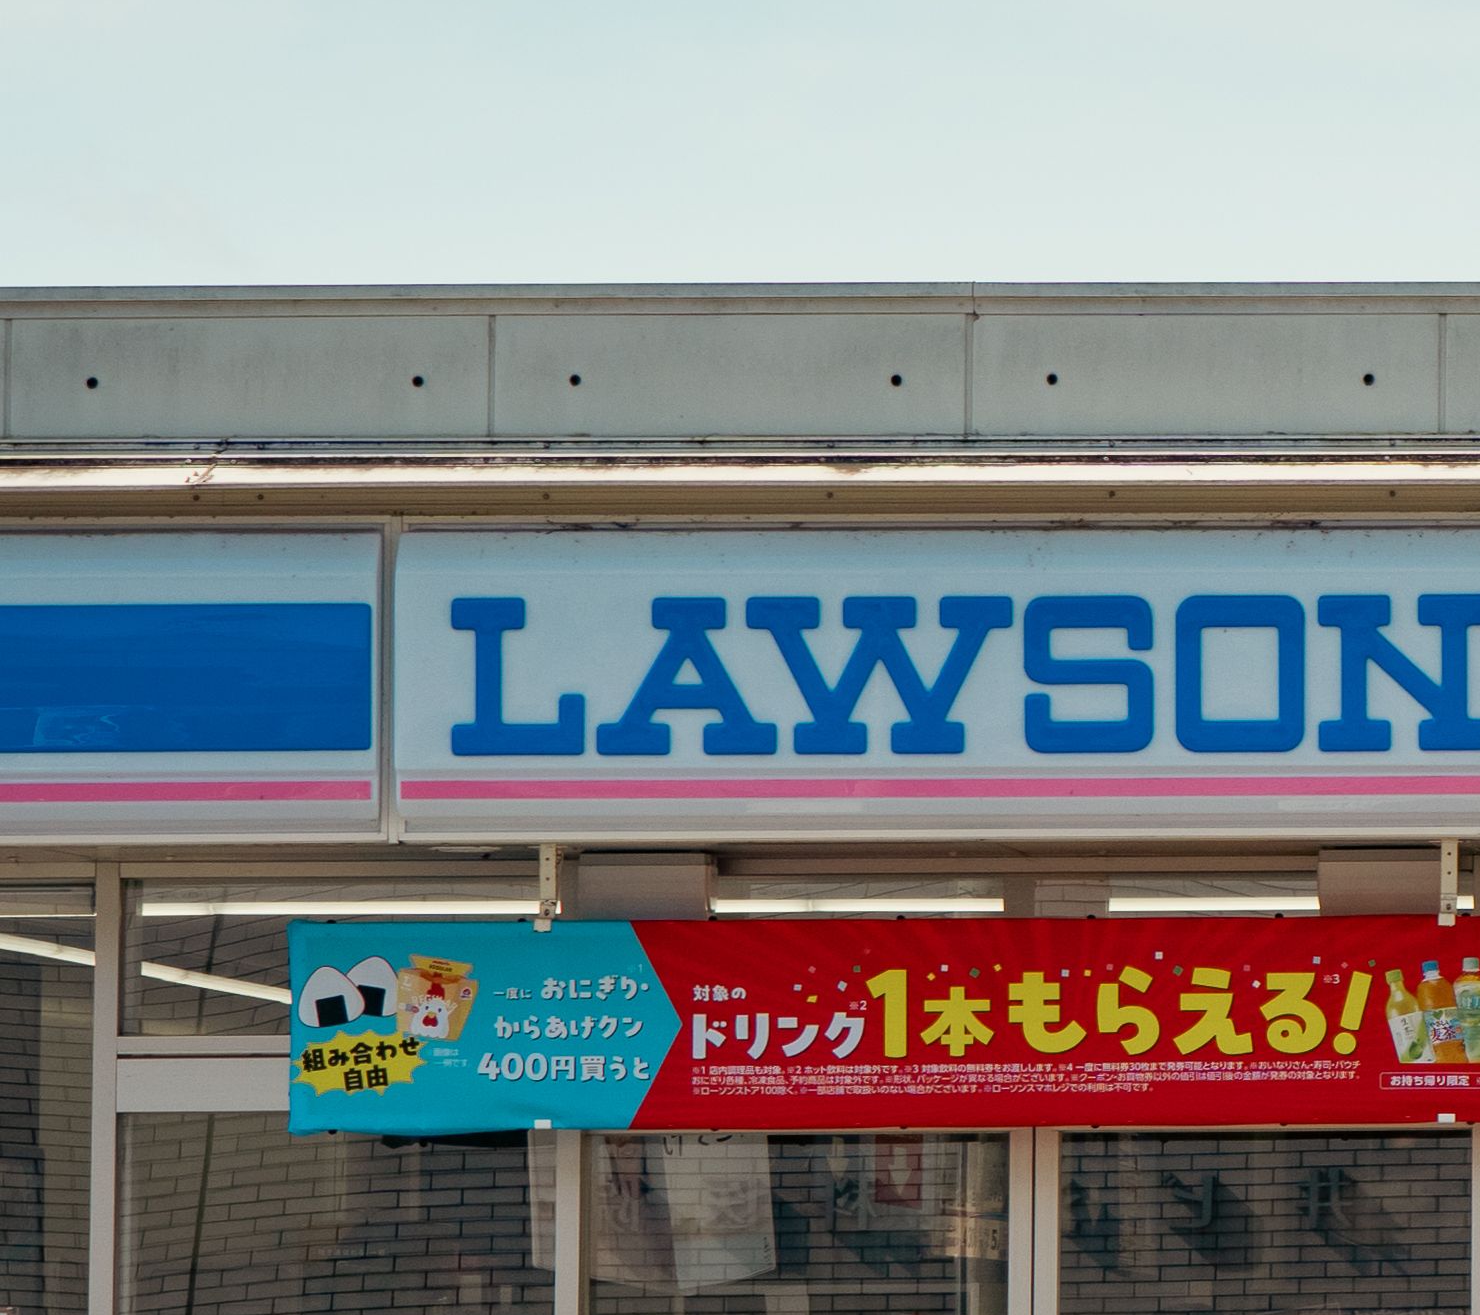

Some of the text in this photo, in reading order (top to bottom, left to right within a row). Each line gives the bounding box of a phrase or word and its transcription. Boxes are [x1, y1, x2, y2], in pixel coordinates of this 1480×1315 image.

[1323, 974, 1340, 984] ※3
[493, 987, 531, 1000] 一度に
[693, 984, 746, 1002] 対象の
[848, 1000, 867, 1011] ※2
[865, 965, 1374, 1060] 1本もらえる!
[494, 1015, 643, 1040] からあげクン
[692, 1011, 864, 1060] ドリンク
[302, 1037, 420, 1073] 組み合わせ
[477, 1051, 651, 1082] 400円買うと
[344, 1066, 389, 1092] 自由
[1390, 1075, 1469, 1086] お持ち帰り限定
